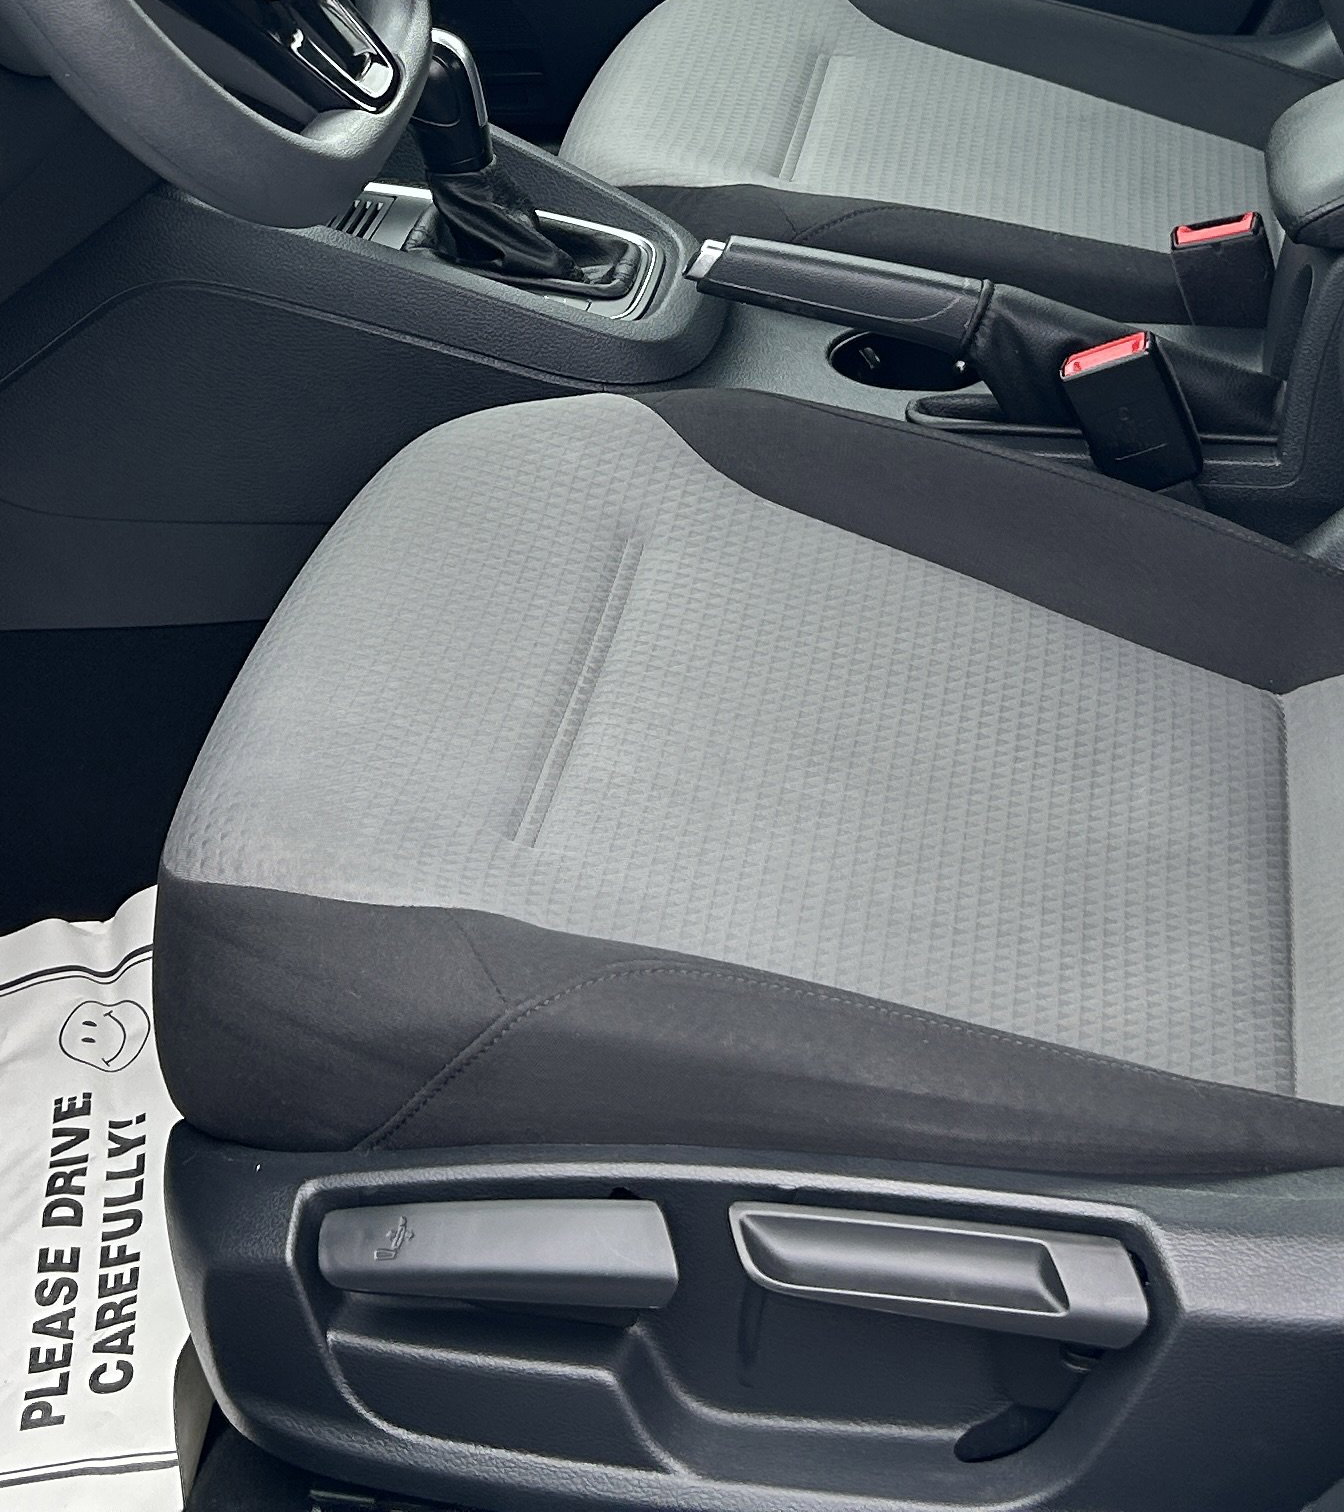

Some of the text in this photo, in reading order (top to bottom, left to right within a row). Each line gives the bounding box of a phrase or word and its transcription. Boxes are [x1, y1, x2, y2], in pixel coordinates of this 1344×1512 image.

[19, 1091, 93, 1432] PLEASE DRIVE
[88, 1112, 147, 1395] CAREFULLY!
